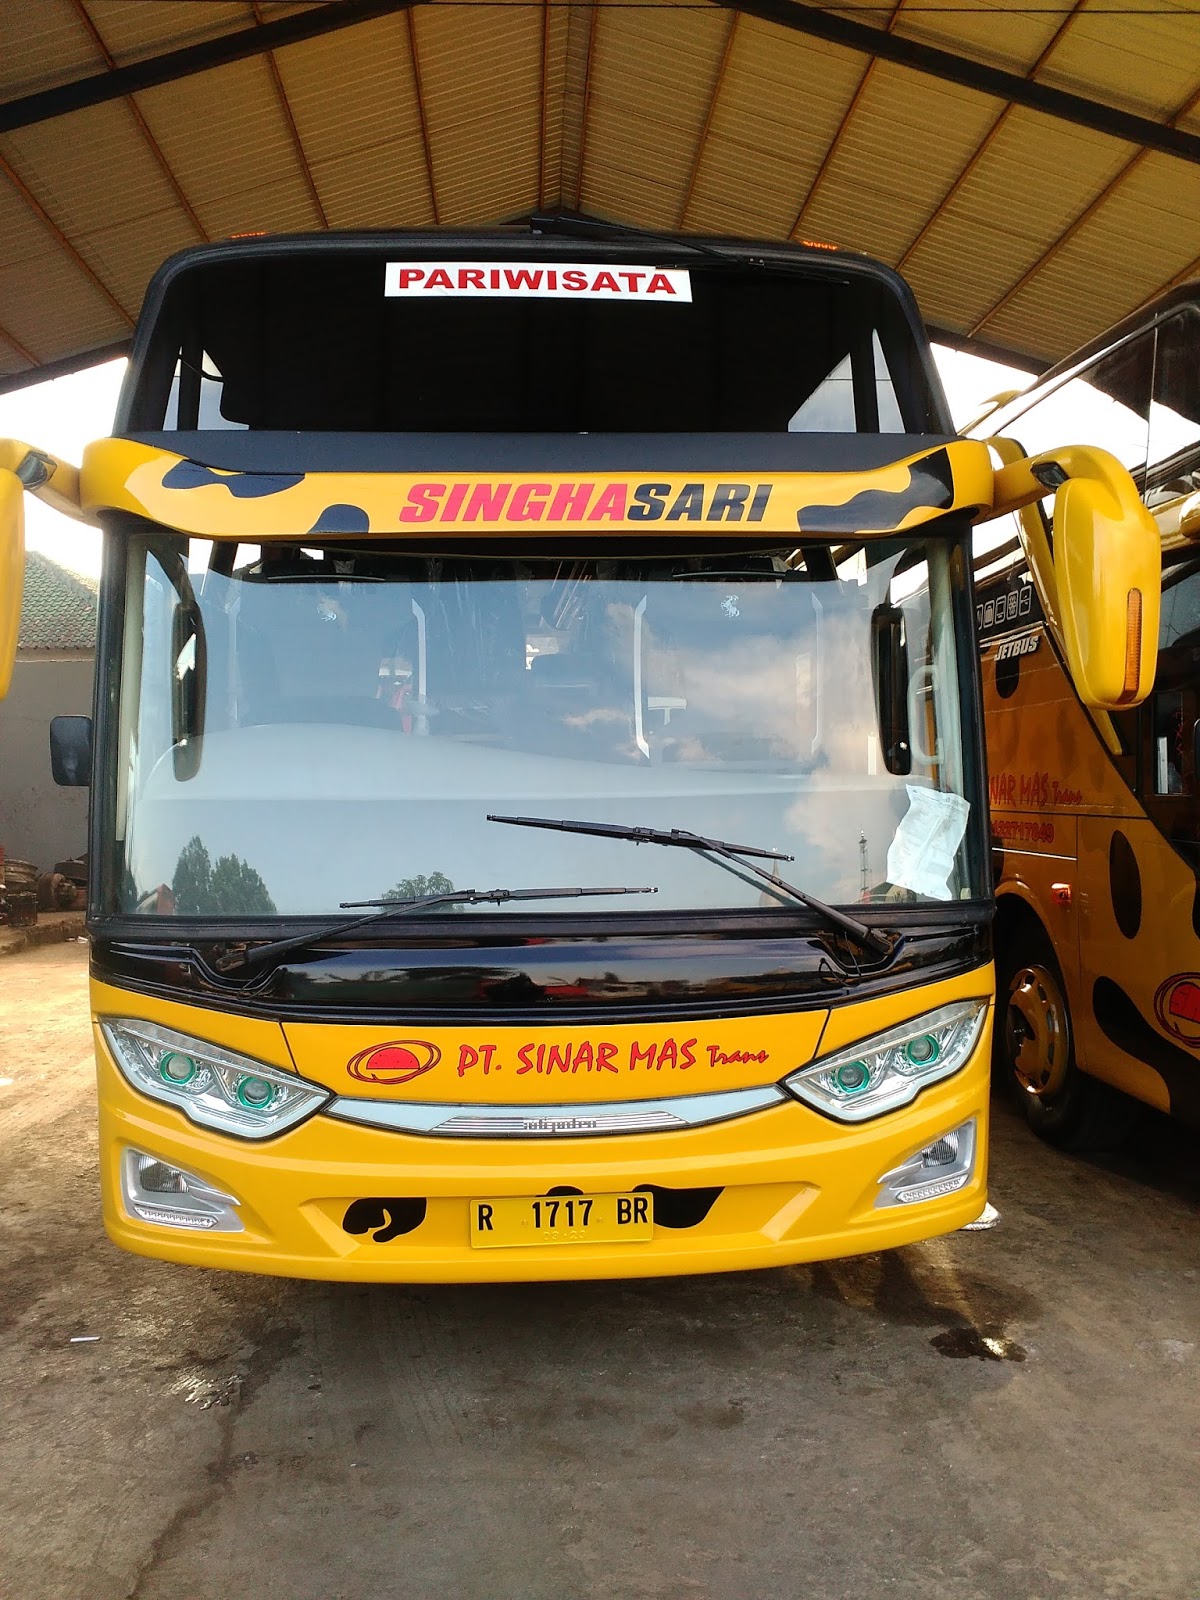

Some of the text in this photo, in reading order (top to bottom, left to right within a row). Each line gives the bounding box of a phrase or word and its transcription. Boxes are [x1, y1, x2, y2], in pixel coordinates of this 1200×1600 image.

[399, 268, 677, 295] PARIWISATA
[399, 483, 773, 522] SINGHASARI
[994, 635, 1039, 661] JETBUS
[1020, 771, 1049, 807] MAS
[457, 1038, 769, 1077] PT. SINAR MAS Trans
[478, 1196, 648, 1231] R 1717 BR
